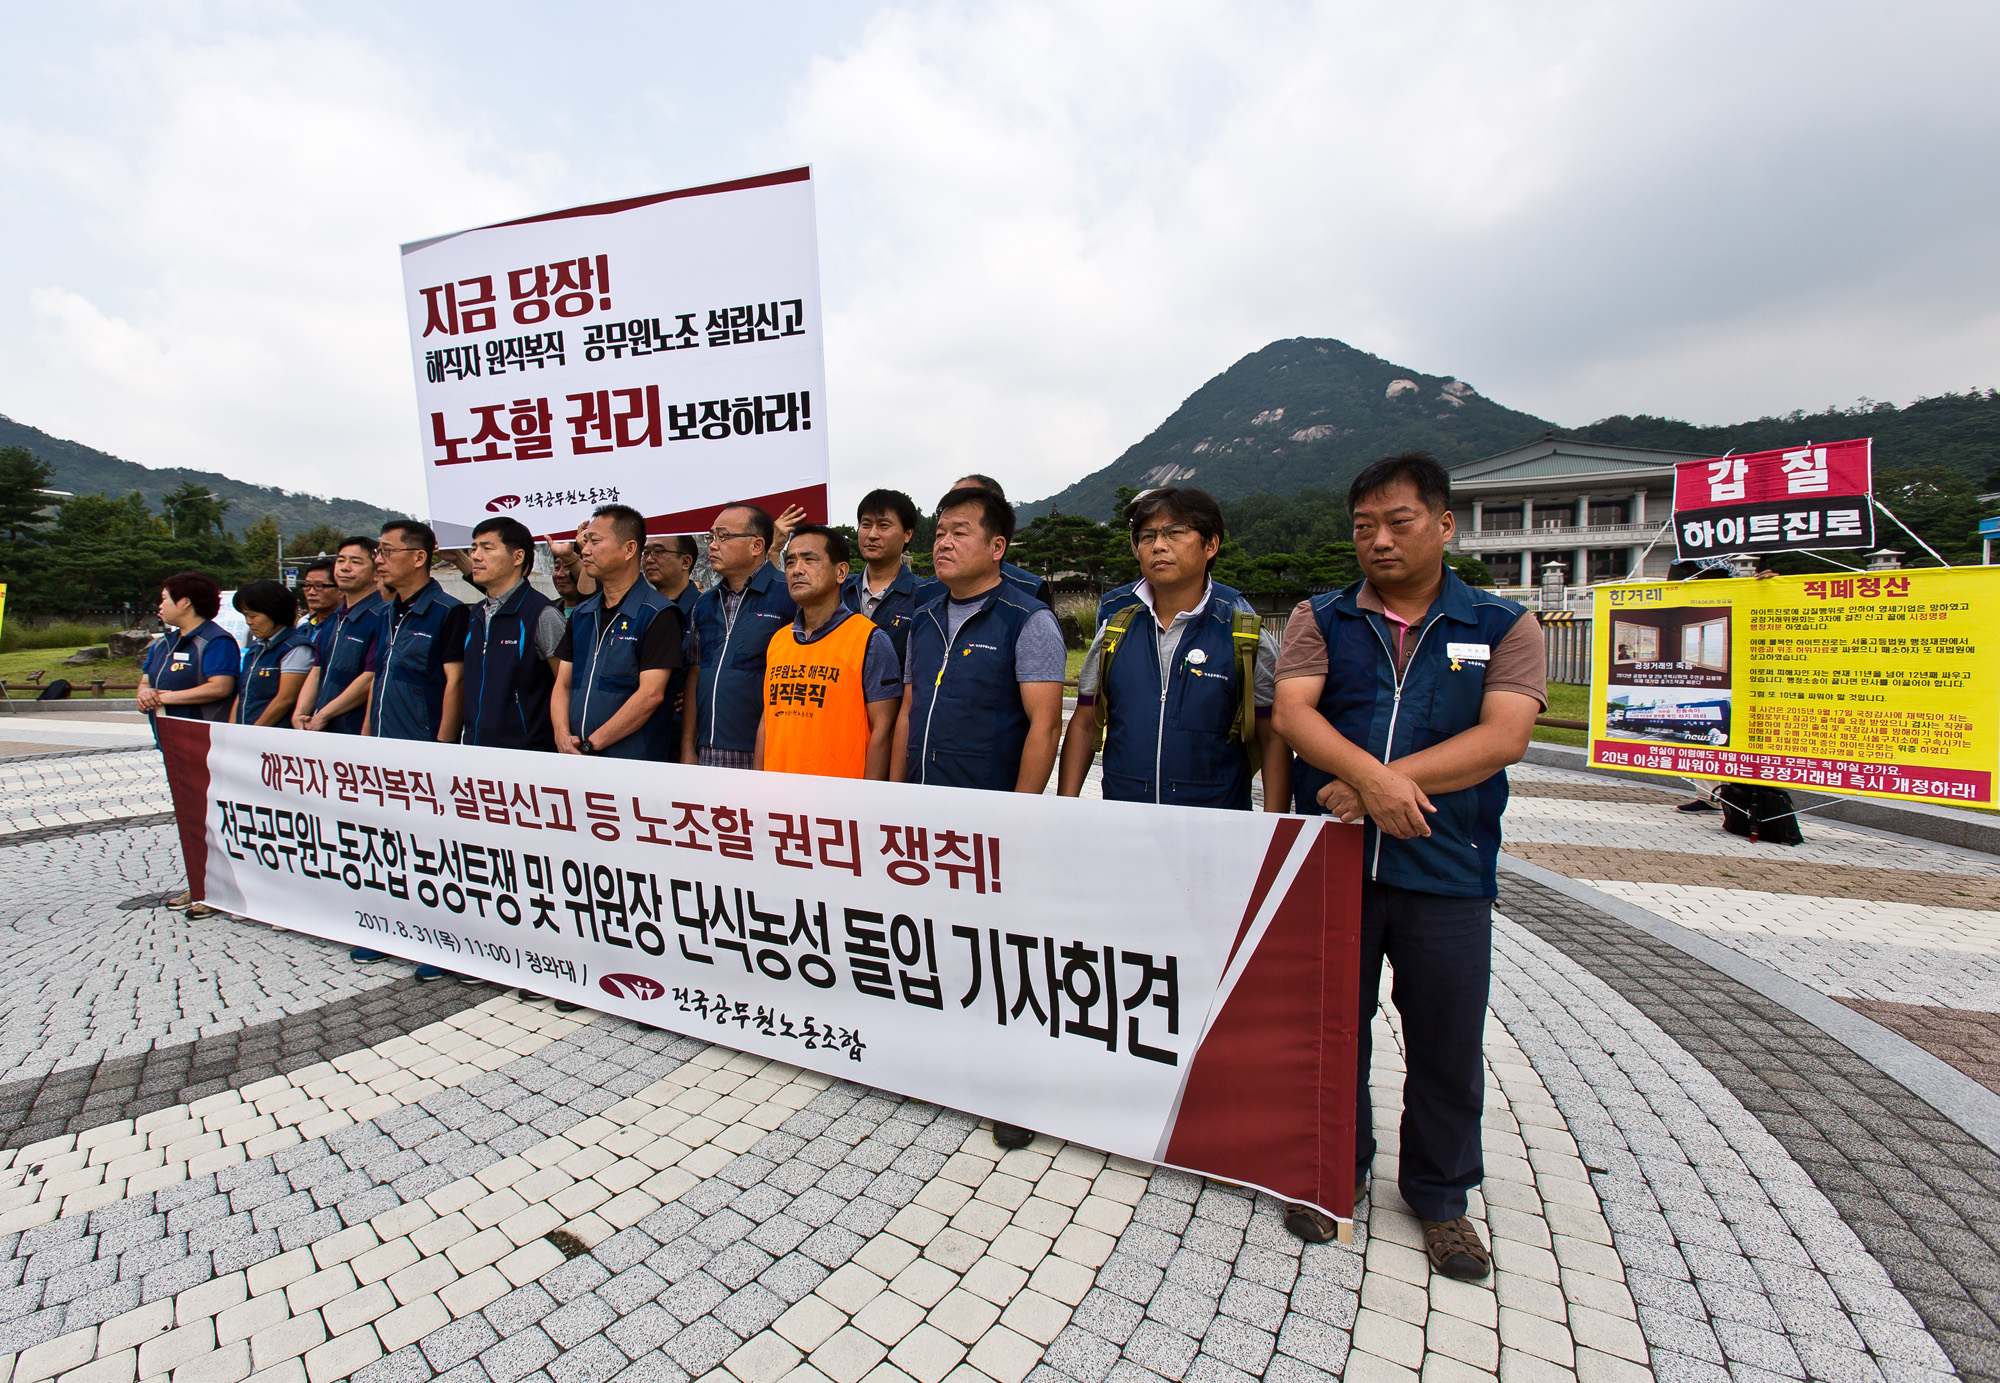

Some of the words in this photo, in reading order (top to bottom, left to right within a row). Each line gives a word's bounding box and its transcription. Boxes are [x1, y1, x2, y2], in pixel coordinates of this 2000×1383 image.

[419, 275, 497, 338] 지금
[507, 254, 612, 325] 당장!
[425, 344, 481, 383] 해직자
[485, 331, 565, 376] 원직복직
[583, 313, 700, 362] 공무원노조
[705, 299, 805, 347] 설립신고
[431, 397, 553, 466] 노조할
[566, 384, 662, 455] 권리
[668, 391, 811, 441] 보장하라!
[524, 487, 620, 509] 전국공무원노동조합
[1682, 509, 1863, 549] 하이트진로
[1609, 588, 1662, 606] 한겨레
[1803, 577, 1911, 599] 적폐청산
[1750, 608, 1799, 616] 하이트진로에
[1802, 606, 1845, 615] 갑질행위로
[1848, 606, 1875, 614] 인하여
[1878, 604, 1926, 613] 영세기업은
[1930, 603, 1970, 612] 망하였고
[1750, 616, 1816, 624] 공정거래위원회는
[1865, 613, 1884, 621] 신고
[1909, 612, 1948, 620] 시정명령
[1750, 638, 1766, 646] 이에
[1796, 638, 1848, 646] 하이트진로는
[1851, 638, 1906, 646] 서울고등법원
[1910, 638, 1969, 646] 행정재판에서
[1842, 646, 1878, 654] 싸웠으나
[1881, 646, 1920, 654] 패소하자
[1923, 646, 1932, 654] 또
[1936, 646, 1976, 654] 대법원에
[770, 664, 806, 680] 공무원노조
[808, 665, 840, 683] 해직자
[1634, 662, 1674, 670] 공정거래의
[1749, 668, 1774, 676] 이로써
[1777, 669, 1810, 677] 피해자인
[1812, 670, 1830, 678] 저는
[1832, 670, 1850, 678] 현재
[1854, 670, 1882, 678] 11년을
[1908, 671, 1938, 679] 12년째
[1942, 671, 1971, 680] 싸우고
[1786, 677, 1828, 685] 행정소송이
[1832, 678, 1858, 686] 끝나면
[770, 682, 826, 708] 원직복직
[1780, 692, 1804, 700] 10년을
[1808, 692, 1834, 700] 싸워야
[1760, 706, 1784, 714] 사건은
[1786, 707, 1814, 715] 2015년
[1817, 708, 1830, 716] 9월
[1856, 710, 1903, 720] 국정감사에
[1948, 714, 1967, 722] 저는
[1912, 720, 1940, 730] 검사는
[1944, 722, 1974, 731] 직권을
[1934, 730, 1964, 740] 위하여
[1748, 742, 1764, 750] 이에
[1840, 741, 1894, 752] 하이트진로는
[1650, 746, 1676, 757] 현실이
[1718, 752, 1737, 762] 내일
[1740, 754, 1782, 766] 아니라고
[1785, 757, 1818, 769] 모르는
[1821, 760, 1832, 770] 척
[1836, 761, 1860, 773] 하실
[1863, 764, 1902, 776] 건가요.
[1601, 751, 1628, 765] 20년
[1633, 753, 1673, 769] 이상을
[1677, 758, 1720, 774] 싸워야
[1724, 762, 1754, 778] 하는
[1760, 765, 1842, 786] 공정거래법
[1850, 776, 1884, 790] 즉시
[1892, 777, 1976, 798] 개정하라!
[260, 751, 329, 799] 해직자
[334, 763, 447, 818] 원직복직,
[448, 778, 577, 833] 설립신고
[584, 793, 621, 842] 등
[635, 797, 754, 862] 노조할
[768, 812, 862, 877] 권리
[880, 824, 1002, 895] 쟁취!
[216, 799, 410, 901] 전국공무원노동조합
[412, 832, 522, 928] 농성투쟁
[523, 853, 561, 934] 및
[560, 859, 666, 957] 위원장
[670, 879, 837, 989] 단식농성
[843, 907, 944, 1011] 돌입
[952, 924, 1179, 1067] 기자회견
[464, 937, 511, 964] 11:00
[525, 950, 577, 984] 청와대
[671, 987, 867, 1062] 전국공무원노동조합
